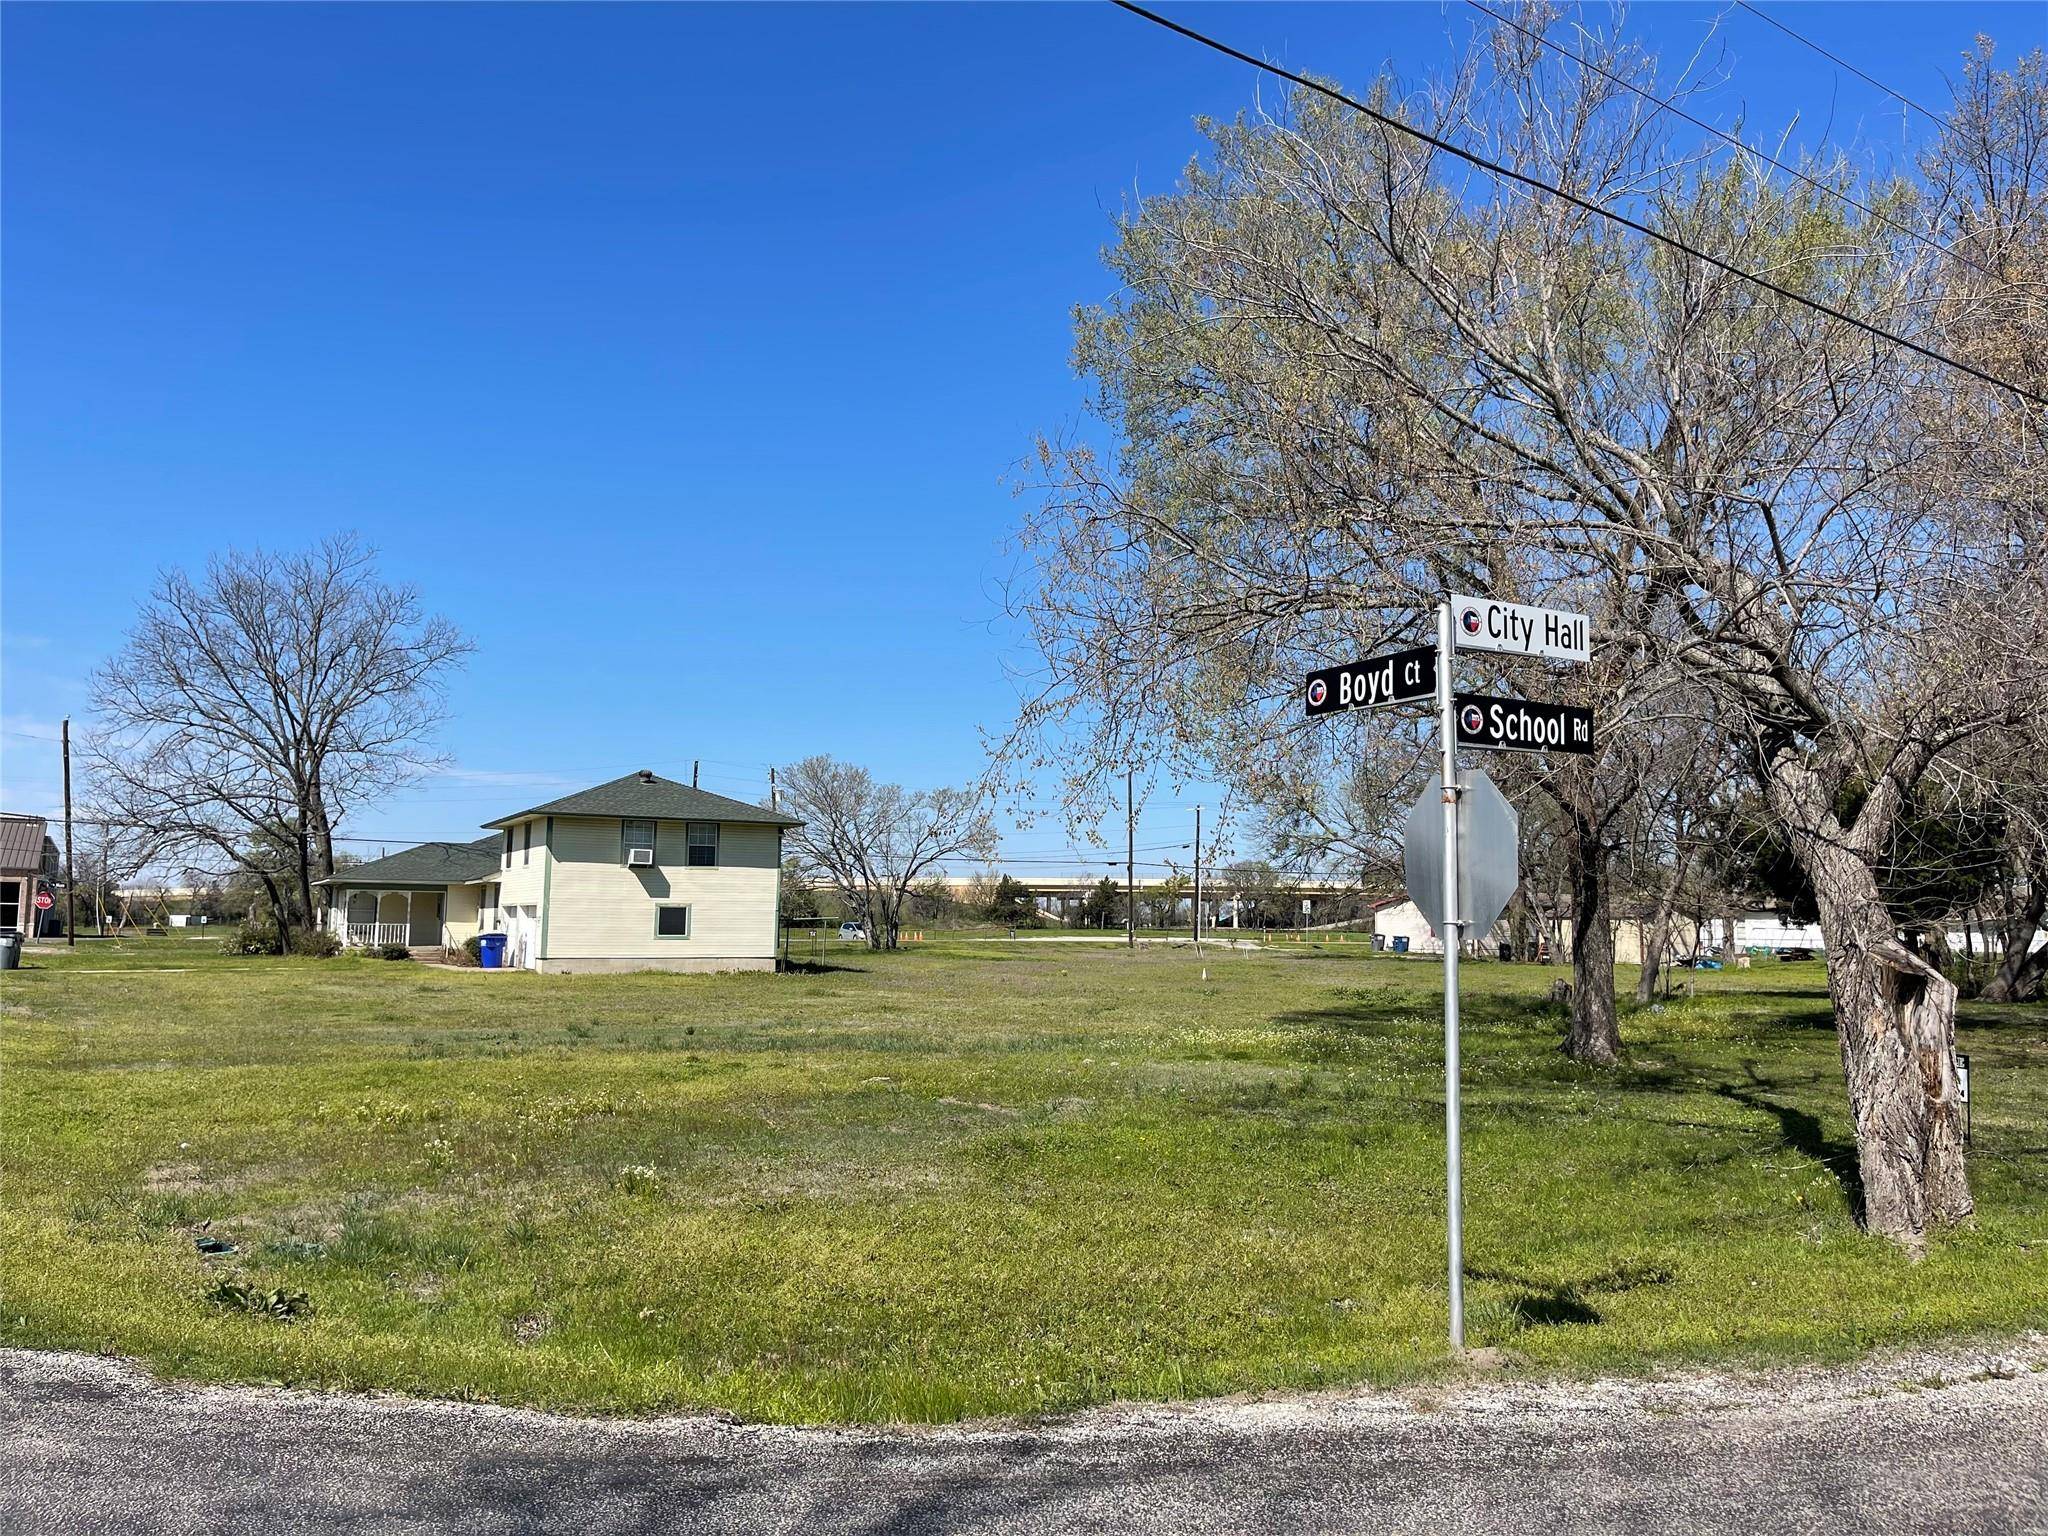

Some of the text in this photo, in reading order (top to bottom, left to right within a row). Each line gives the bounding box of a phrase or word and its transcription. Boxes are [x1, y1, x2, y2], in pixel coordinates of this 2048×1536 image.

[1487, 604, 1584, 651] City Hall
[1339, 660, 1421, 704] Boyd Ct
[1489, 703, 1589, 745] School Rd
